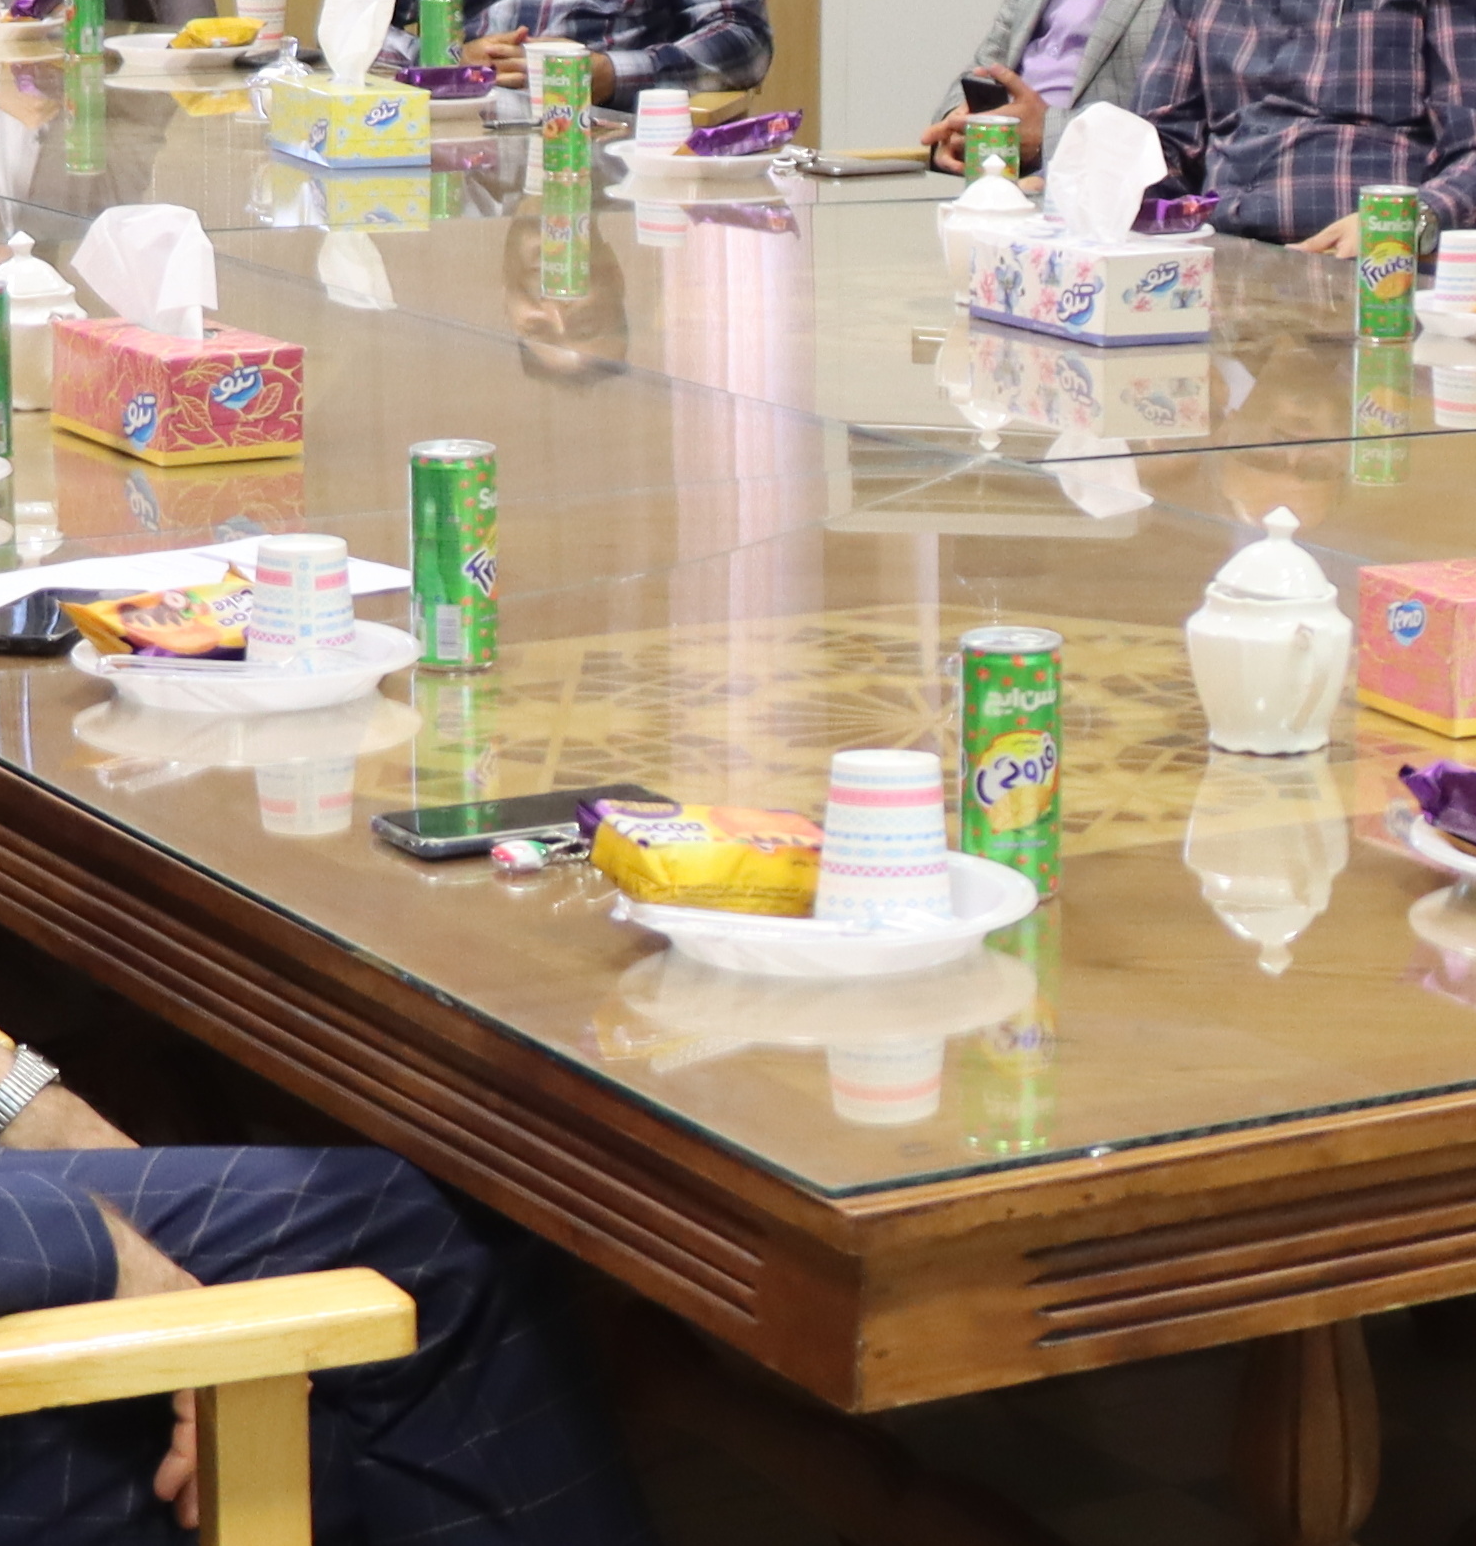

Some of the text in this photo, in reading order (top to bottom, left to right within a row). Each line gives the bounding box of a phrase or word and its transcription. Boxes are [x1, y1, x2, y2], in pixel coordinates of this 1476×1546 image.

[1368, 216, 1414, 232] Sunich
[1056, 283, 1096, 323] تنو
[213, 365, 260, 402] تنو
[124, 395, 157, 436] تنو
